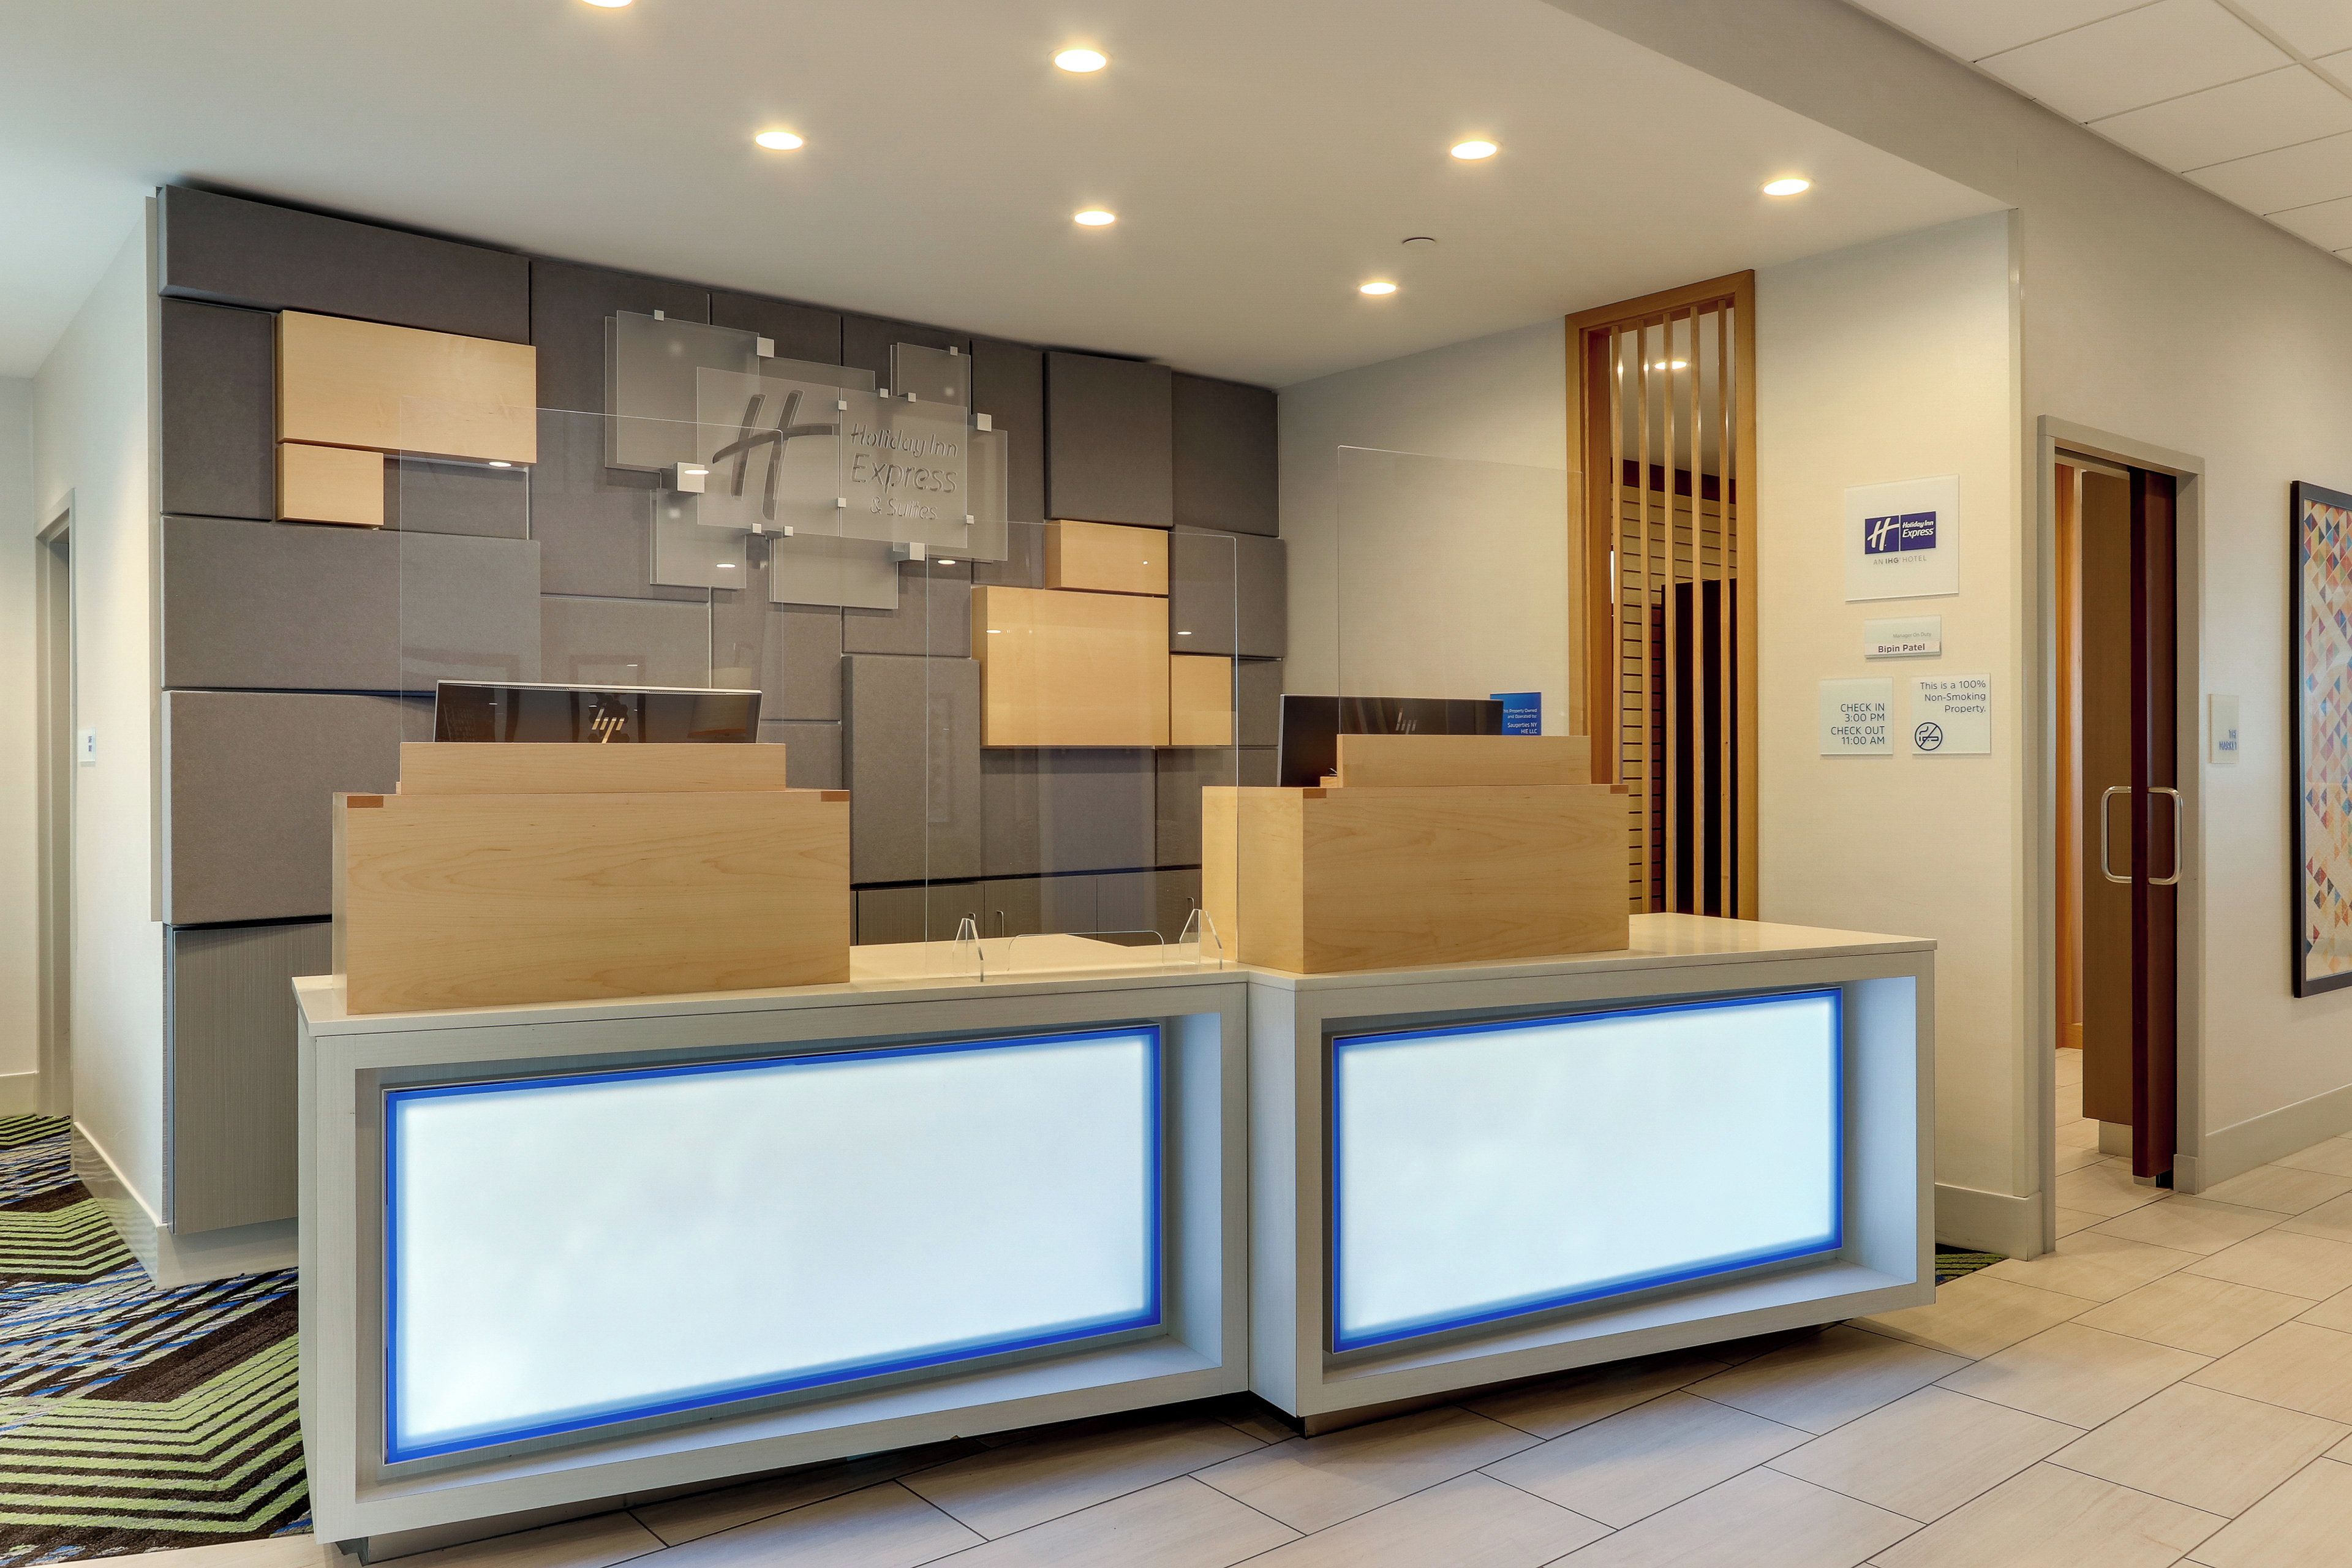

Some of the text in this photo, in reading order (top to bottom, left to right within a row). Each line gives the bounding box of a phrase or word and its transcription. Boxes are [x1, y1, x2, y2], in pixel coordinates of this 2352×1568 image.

[851, 423, 959, 458] Holiday Inn
[851, 452, 958, 494] Express
[870, 496, 939, 520] & Suites
[1902, 527, 1934, 538] Express
[1959, 680, 1986, 688] 100%
[1924, 693, 1986, 701] Non-Smoking
[1841, 703, 1885, 712] CHECK IN
[1945, 704, 1986, 713] Property.
[1845, 713, 1885, 722] 3:00 PM
[1831, 726, 1885, 735] CHECK OUT
